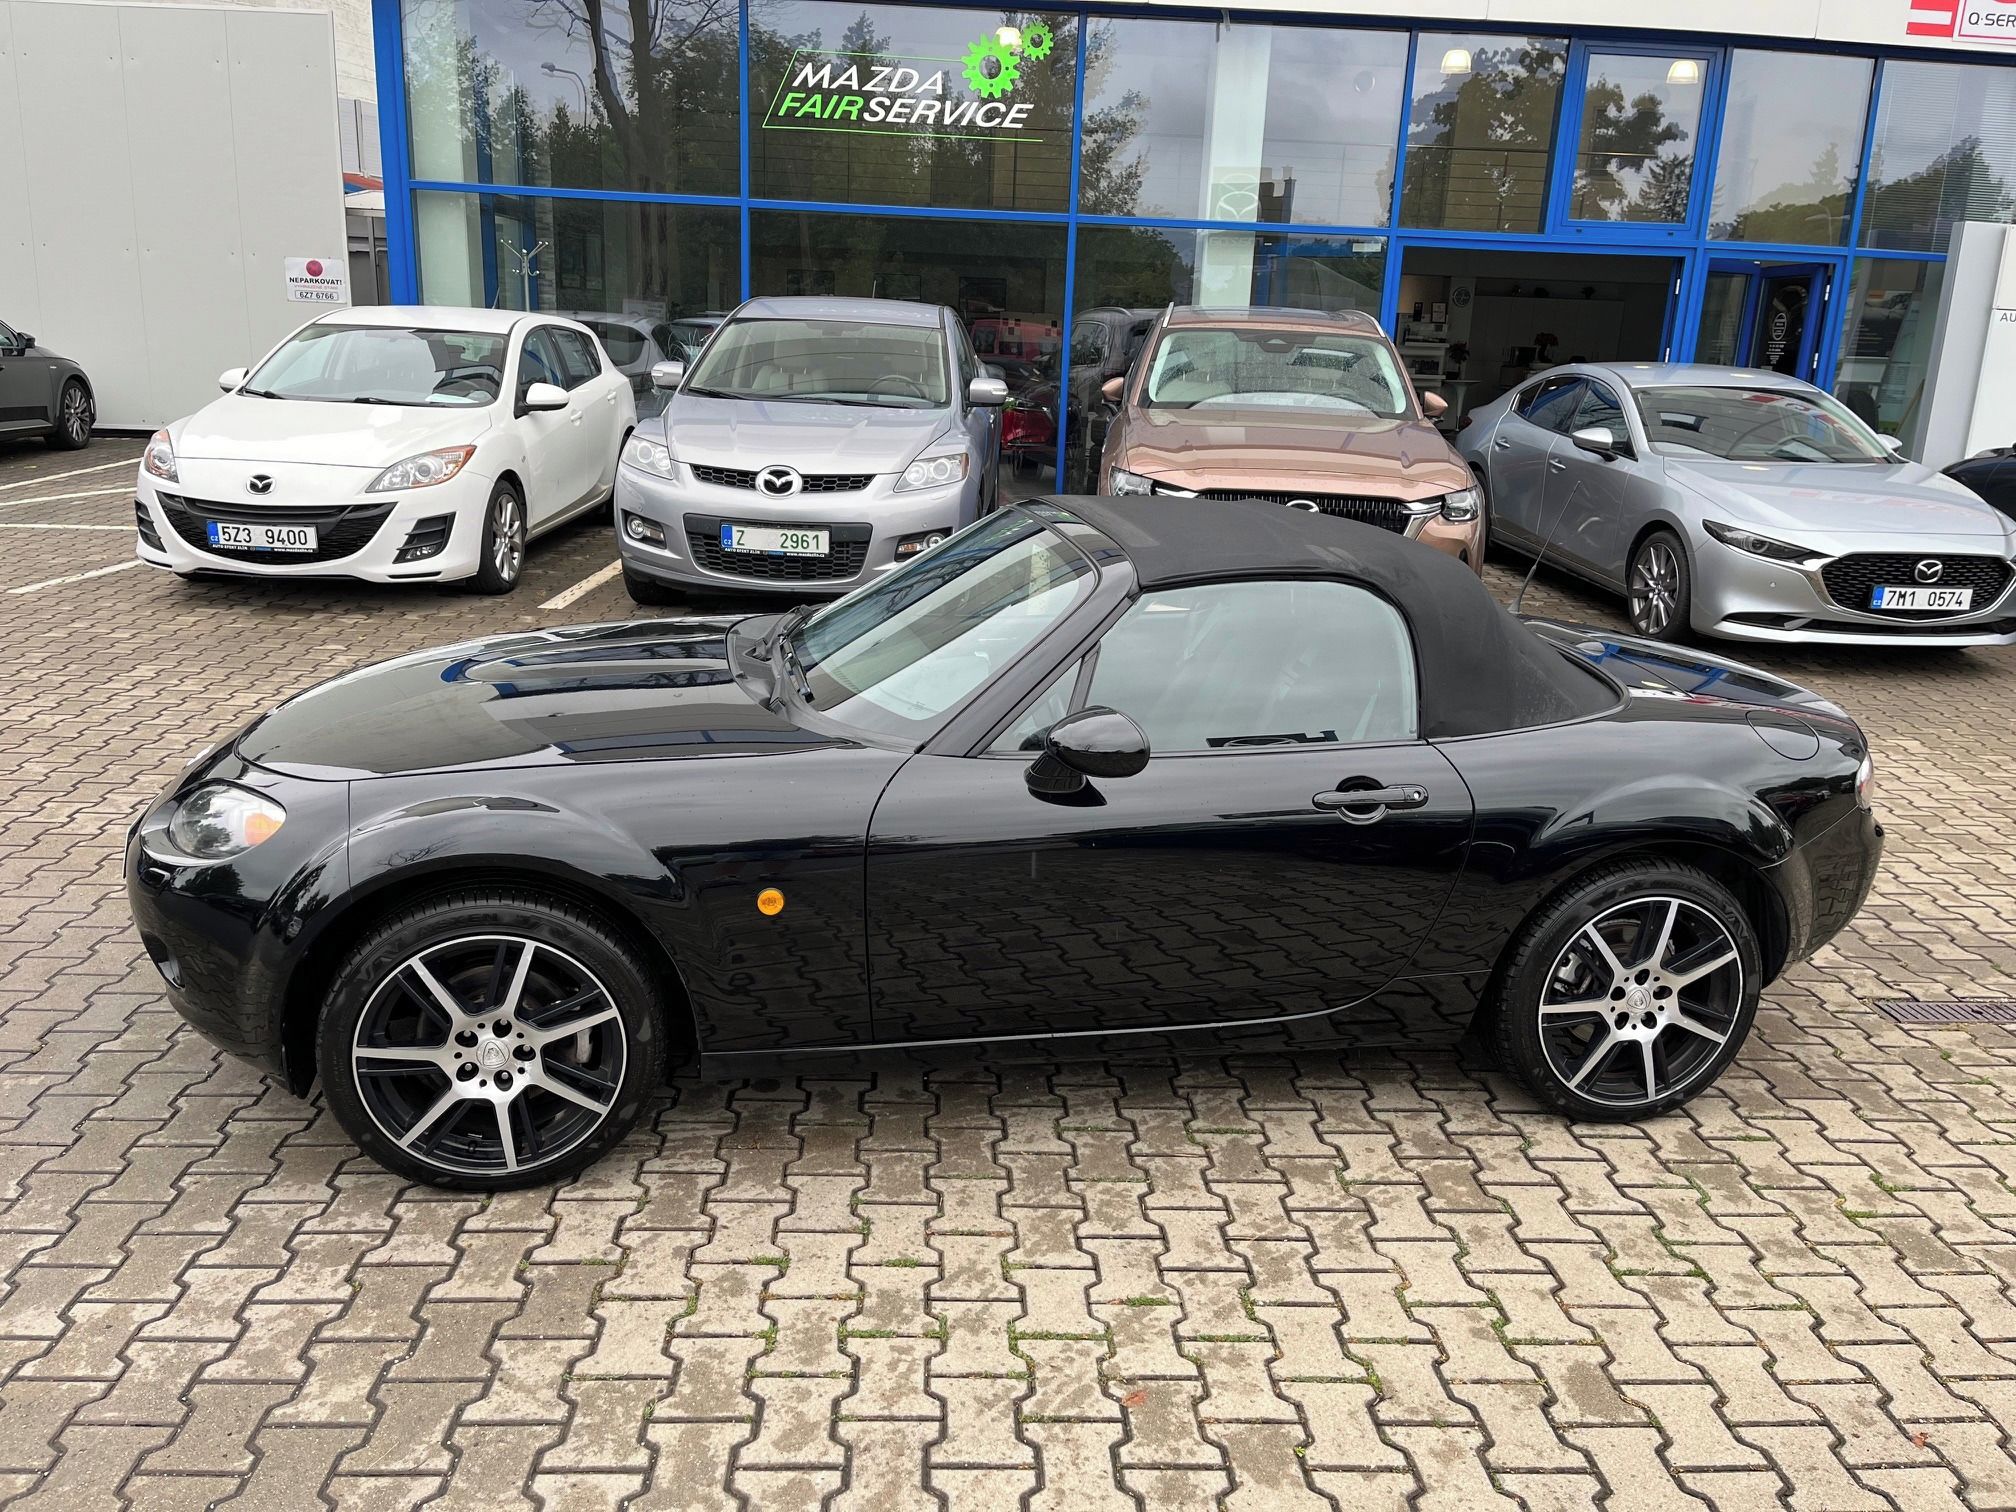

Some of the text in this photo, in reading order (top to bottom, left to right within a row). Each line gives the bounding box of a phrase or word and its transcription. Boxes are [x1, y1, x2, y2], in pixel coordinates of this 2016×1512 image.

[791, 62, 943, 95] MAZDA
[289, 277, 342, 285] NEPARKOVAT!
[221, 526, 252, 543] 5Z3
[265, 528, 308, 545] 9400
[736, 530, 745, 546] Z
[780, 533, 820, 550] 2961
[1887, 590, 1916, 606] 7M1
[1927, 591, 1963, 608] 0574
